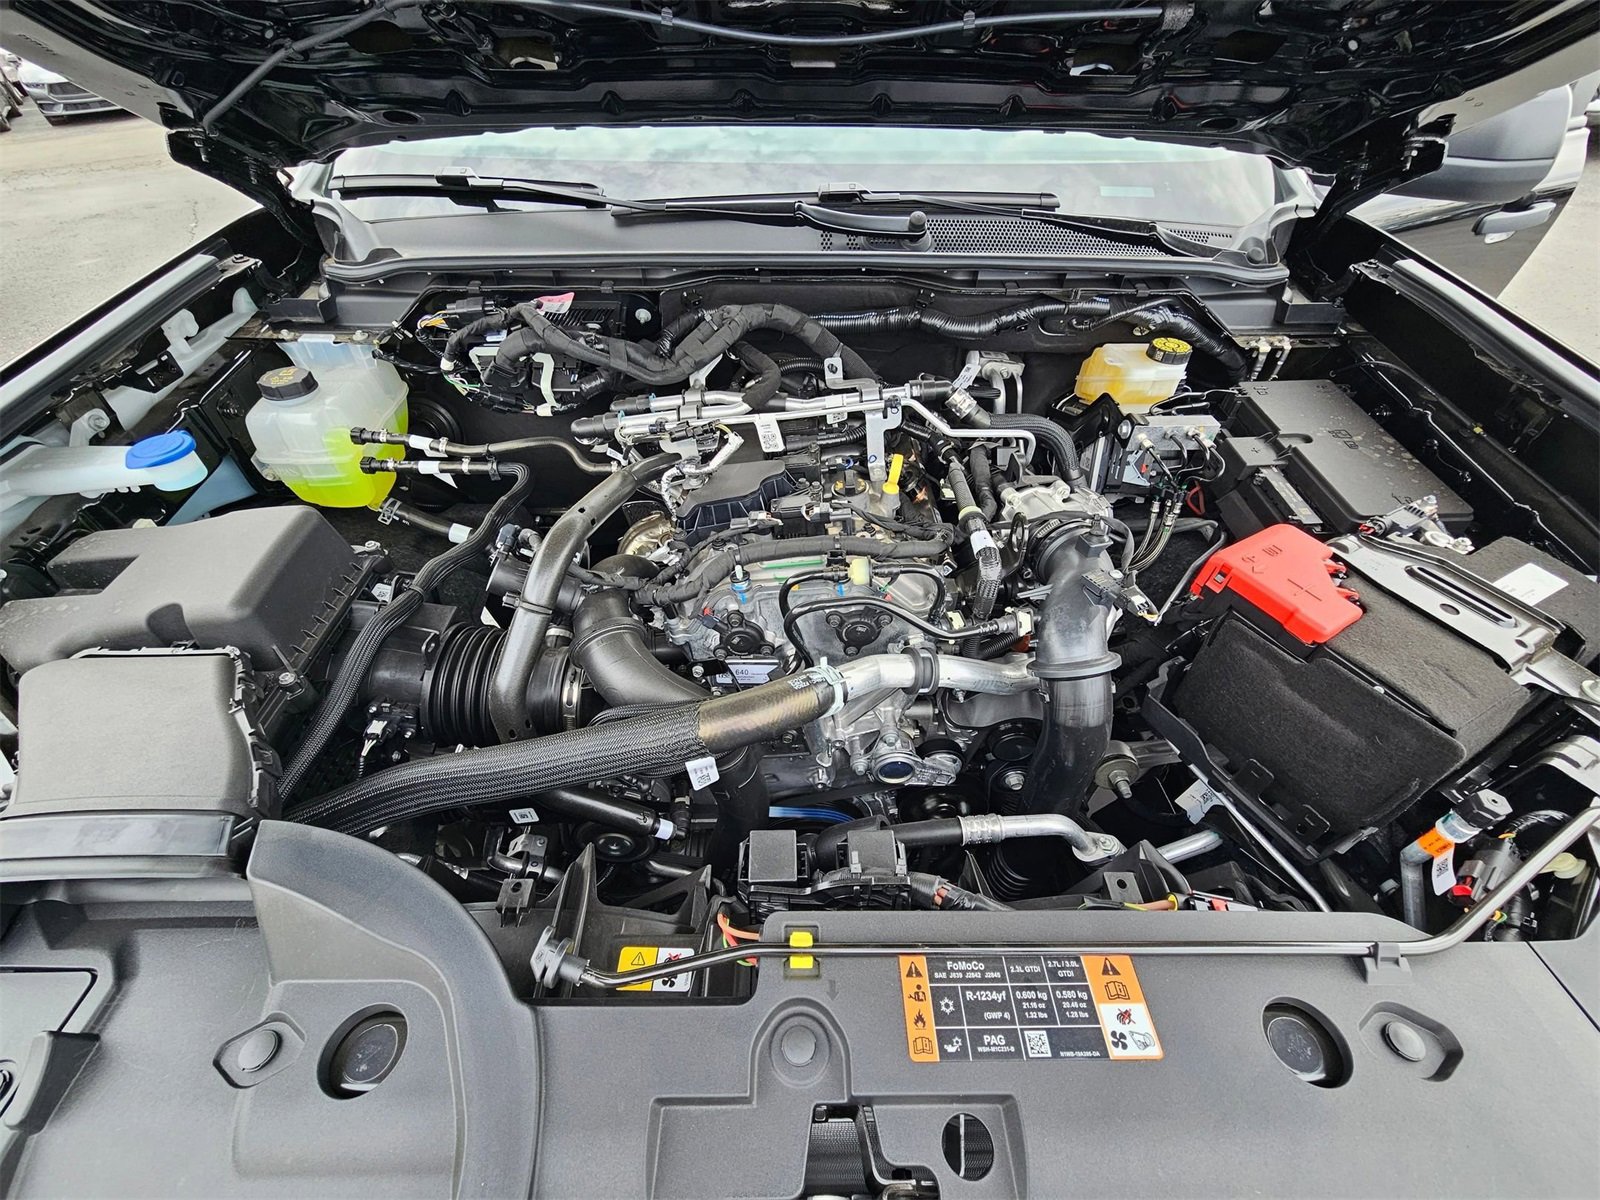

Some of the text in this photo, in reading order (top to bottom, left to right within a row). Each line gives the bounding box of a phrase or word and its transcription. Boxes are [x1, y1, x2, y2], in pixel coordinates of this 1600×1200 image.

[946, 961, 985, 970] FoMoCo
[1024, 965, 1041, 973] GTDI
[965, 990, 1006, 1003] R-1234yf
[1015, 990, 1048, 1001] 0.600 kg
[1055, 990, 1088, 1000] 0.580 kg
[983, 1011, 1011, 1021] (GWP 4)
[1025, 1011, 1038, 1019] 1.32
[983, 1034, 1006, 1046] PAG
